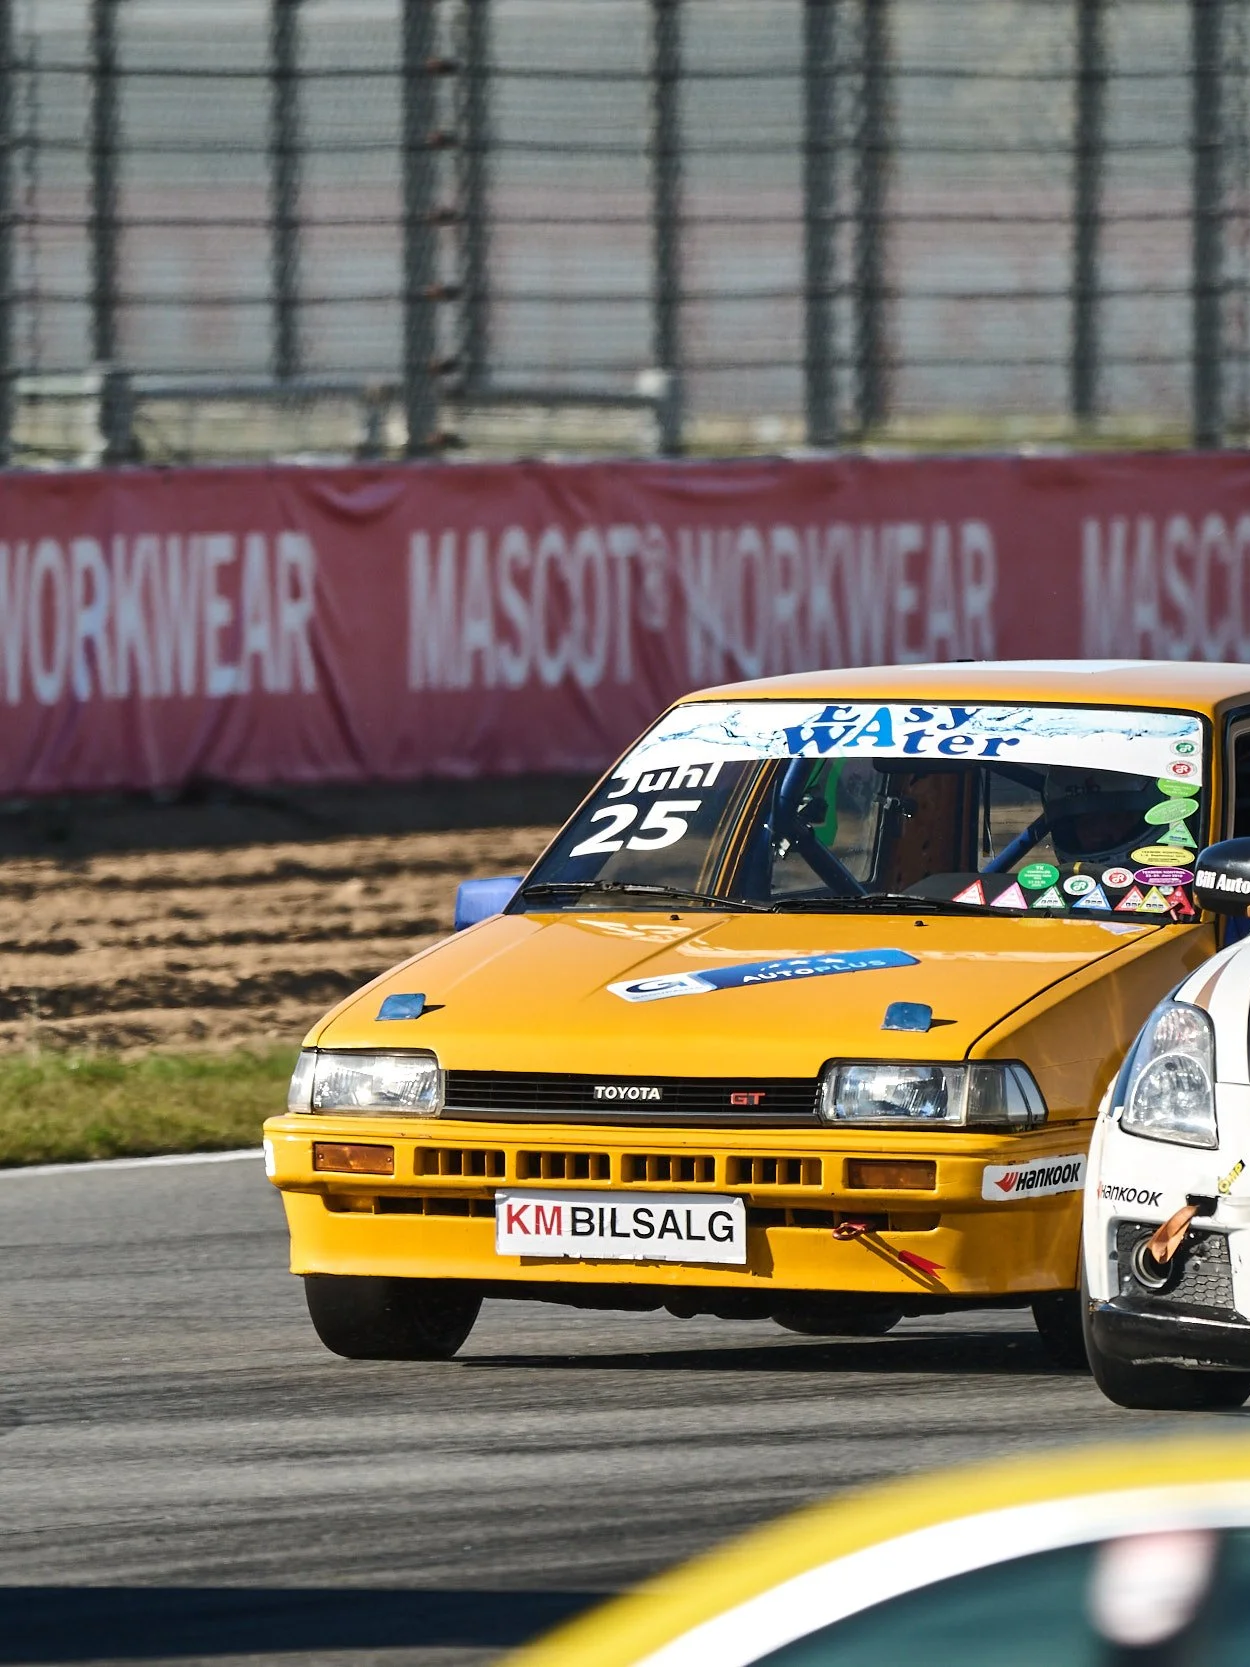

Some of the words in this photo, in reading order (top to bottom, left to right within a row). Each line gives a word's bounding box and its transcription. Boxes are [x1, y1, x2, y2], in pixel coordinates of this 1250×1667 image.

[677, 520, 996, 682] WORKWEAR
[606, 760, 725, 799] Juhl
[568, 799, 703, 858] 25
[1195, 869, 1217, 889] Bili
[594, 1086, 661, 1100] TOYOTA
[730, 1092, 766, 1106] GT
